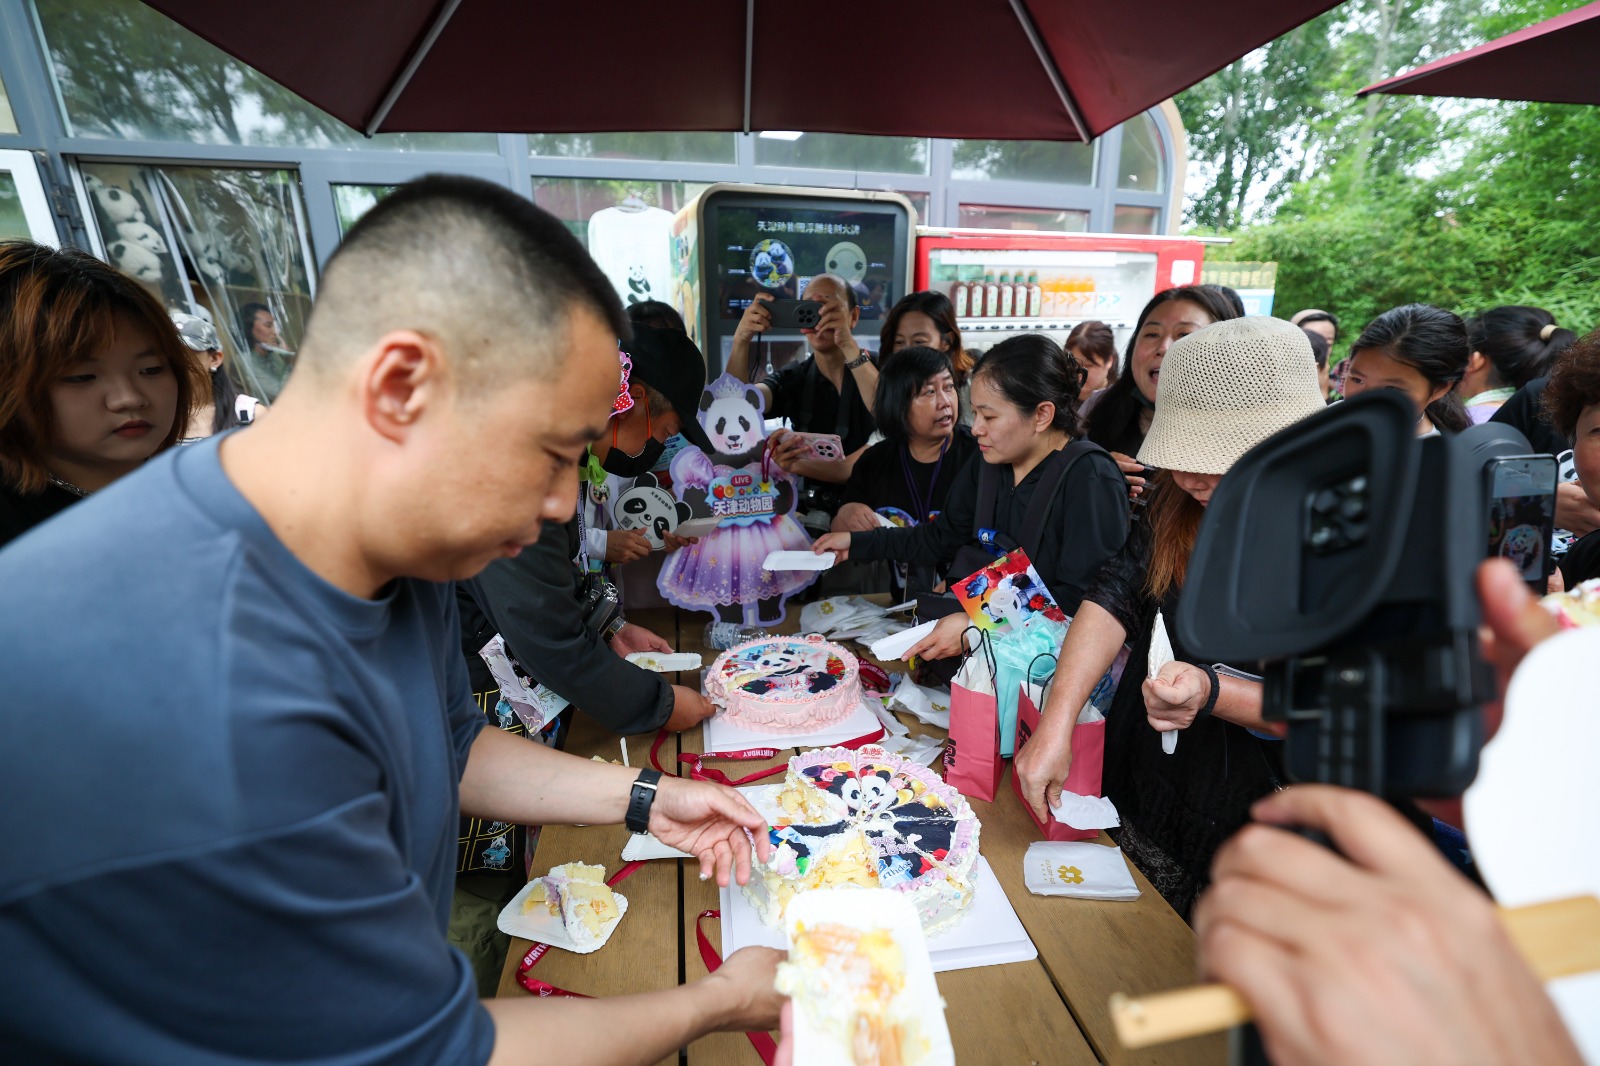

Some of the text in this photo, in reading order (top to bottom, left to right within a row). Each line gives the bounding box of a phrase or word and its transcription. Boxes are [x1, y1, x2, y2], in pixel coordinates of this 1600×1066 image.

[734, 476, 750, 484] LIVE
[714, 496, 774, 516] 天津动物园
[742, 749, 775, 758] BIRTHDAY
